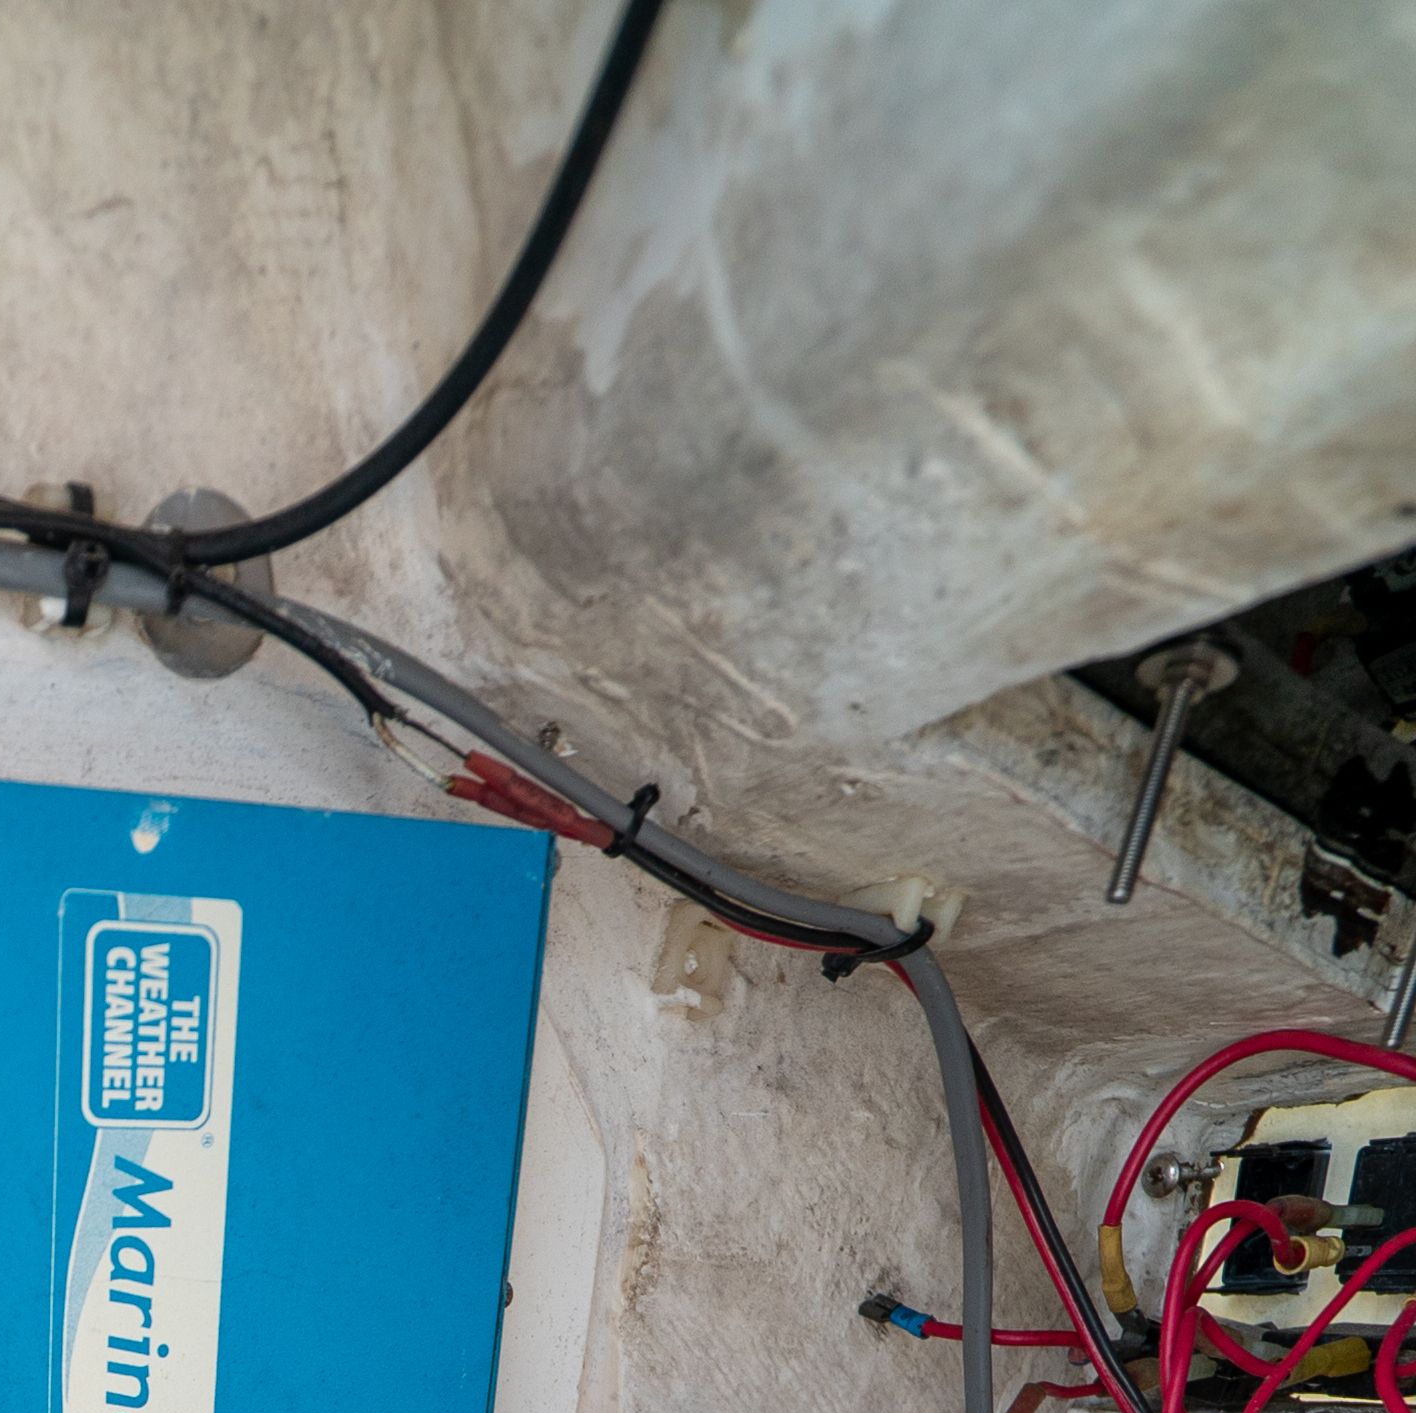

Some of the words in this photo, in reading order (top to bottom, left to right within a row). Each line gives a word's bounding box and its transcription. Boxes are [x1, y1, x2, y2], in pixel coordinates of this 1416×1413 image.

[101, 946, 137, 1109] CHANNEL
[135, 942, 171, 1111] WEATHER
[169, 996, 200, 1063] THE
